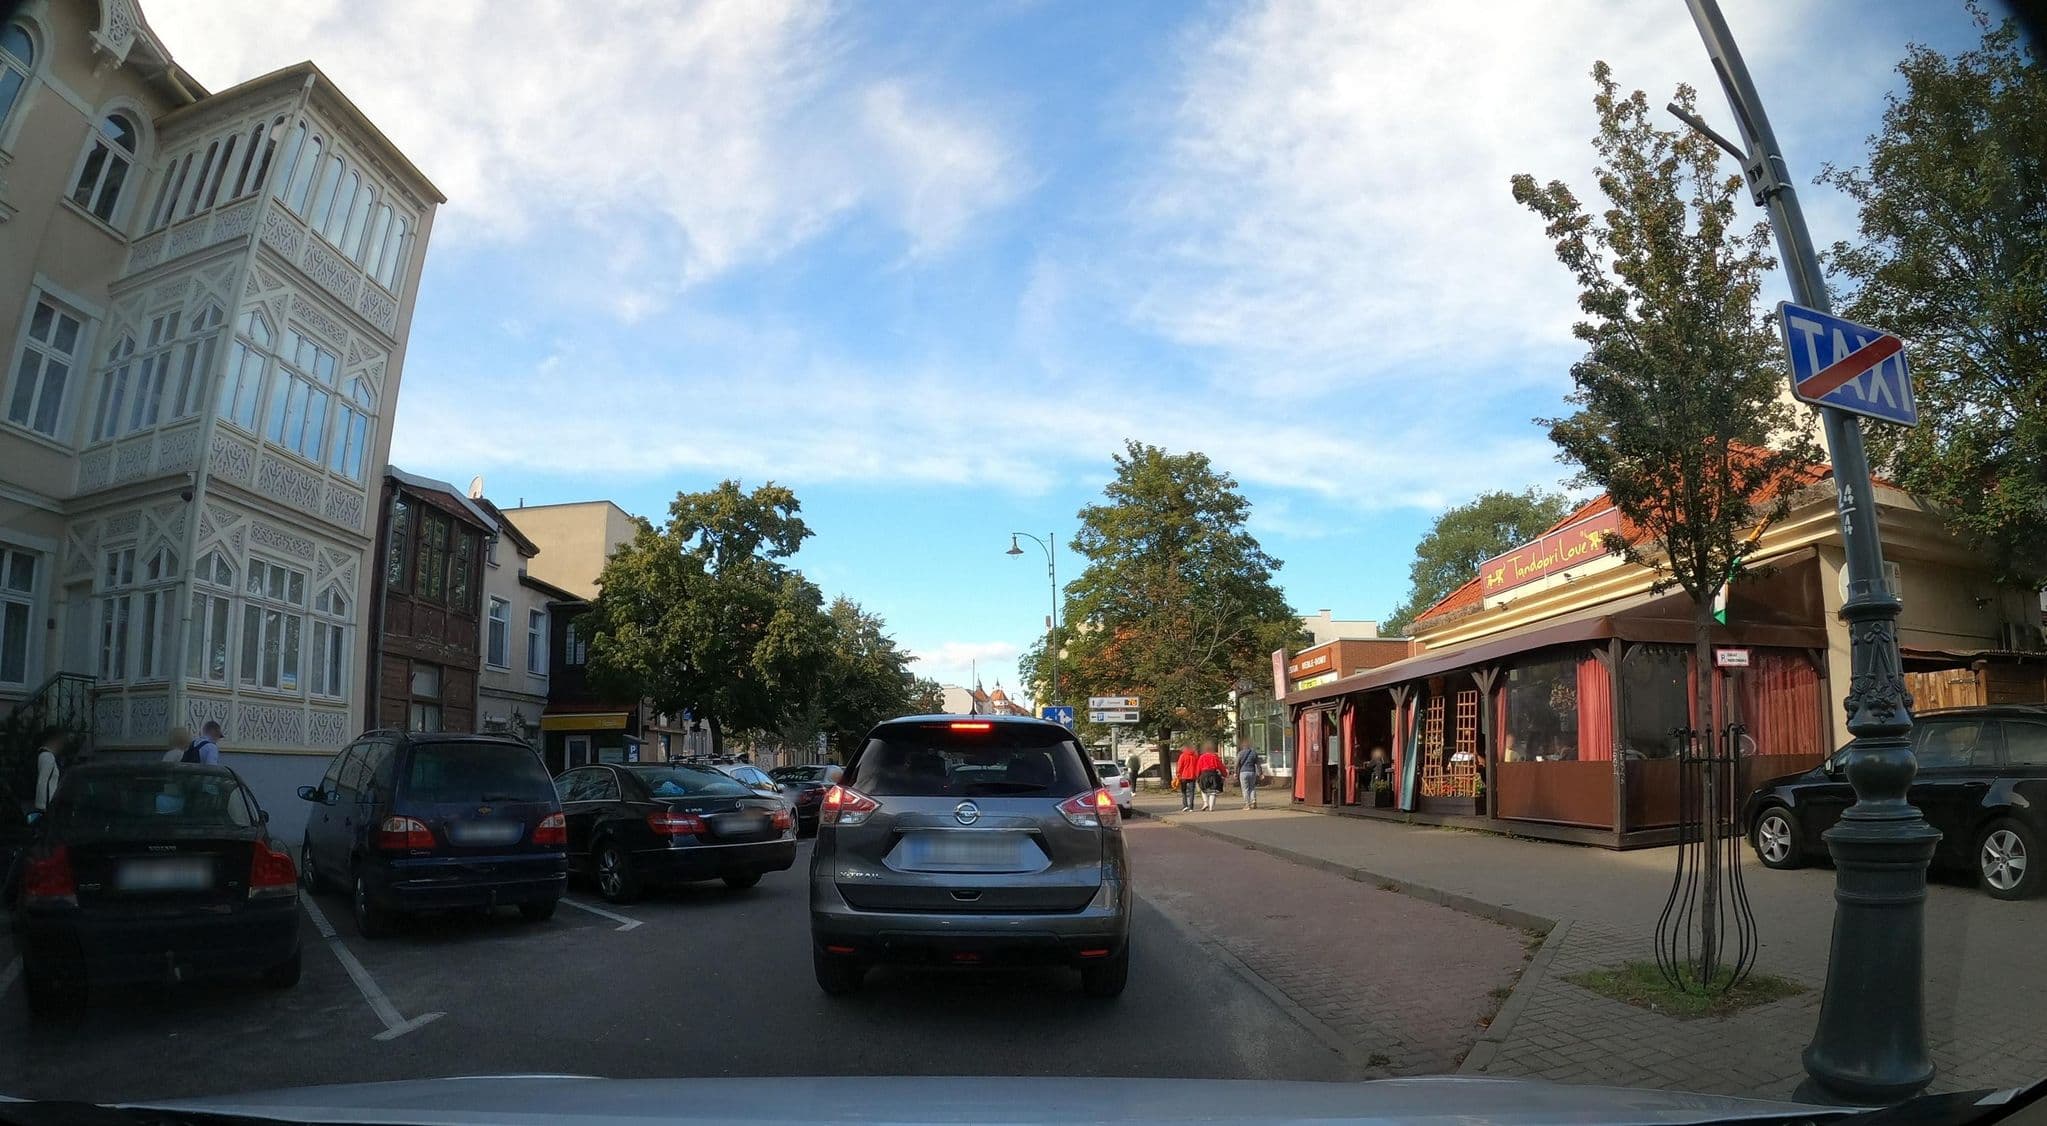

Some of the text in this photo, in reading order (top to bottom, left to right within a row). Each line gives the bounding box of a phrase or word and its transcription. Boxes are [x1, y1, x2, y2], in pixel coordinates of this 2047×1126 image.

[1790, 316, 1911, 412] TAXI
[1507, 538, 1588, 580] Tandoori Love
